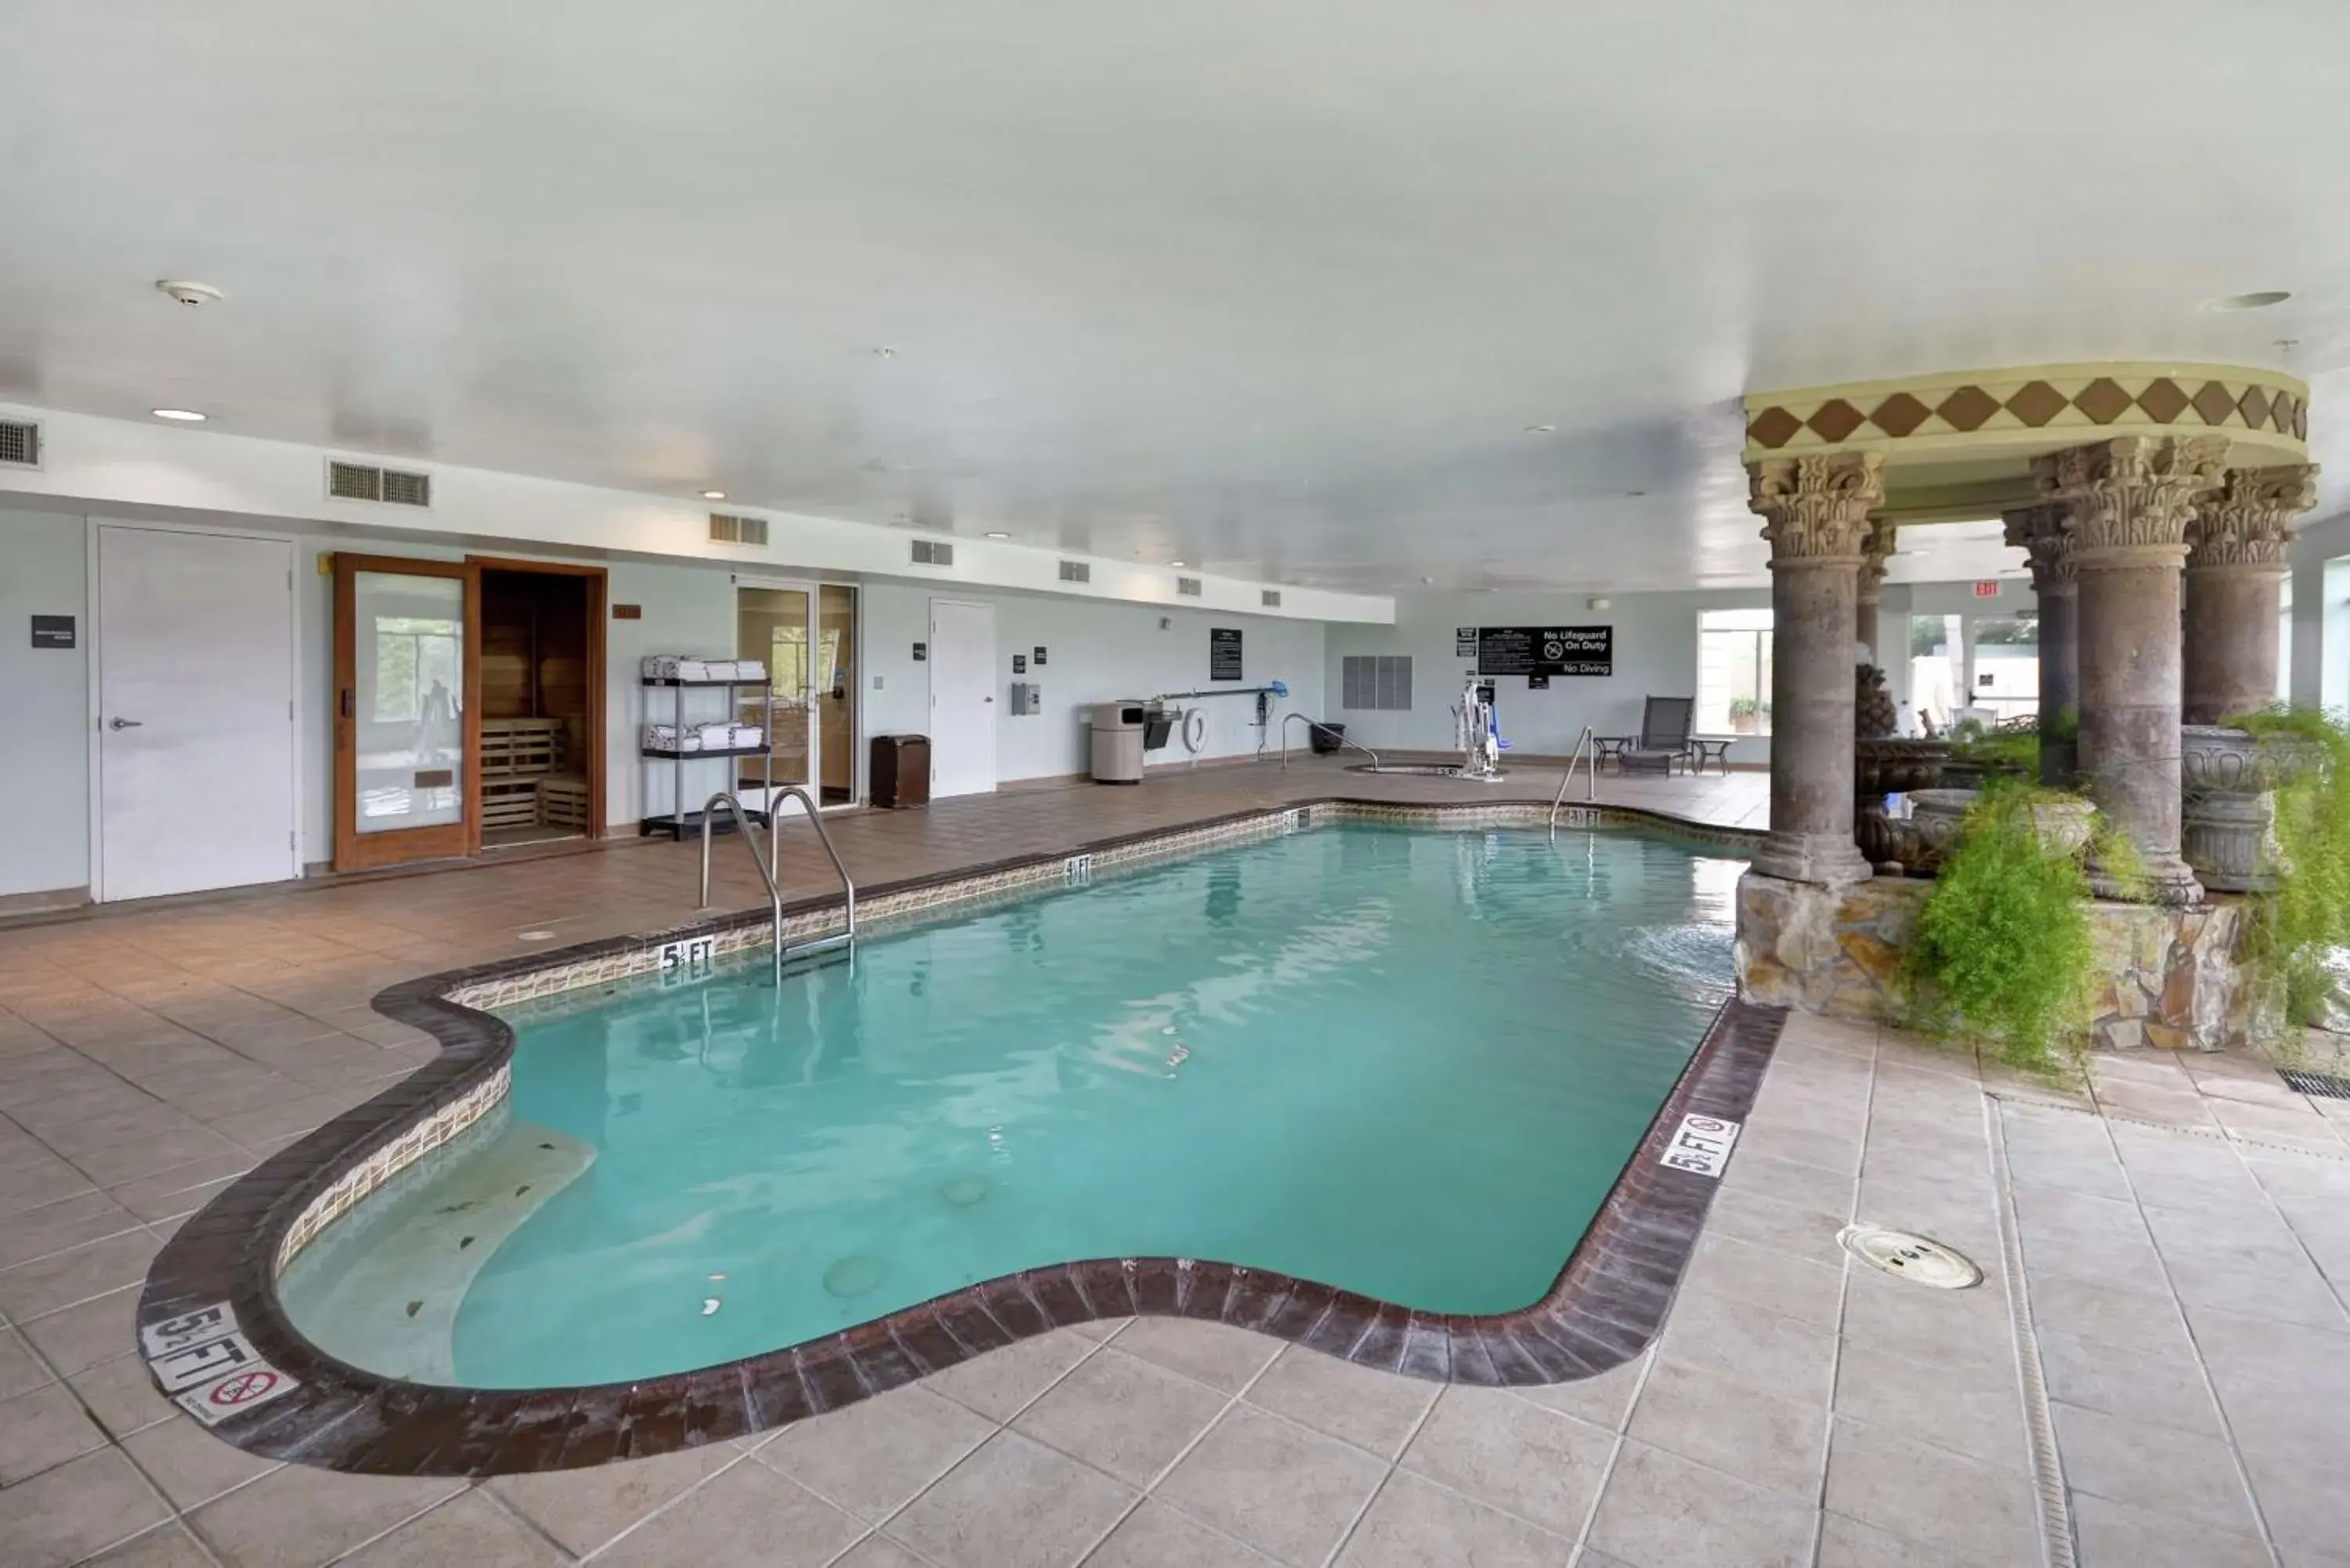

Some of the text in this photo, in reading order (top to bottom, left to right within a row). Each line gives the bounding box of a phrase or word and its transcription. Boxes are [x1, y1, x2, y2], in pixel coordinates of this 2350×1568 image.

[1544, 630, 1607, 641] No Lifeguard
[1582, 641, 1607, 652] Duty
[1564, 664, 1609, 674] No Diving
[690, 940, 712, 962] FT
[1679, 1132, 1723, 1154] FT
[164, 1337, 246, 1379] FT
